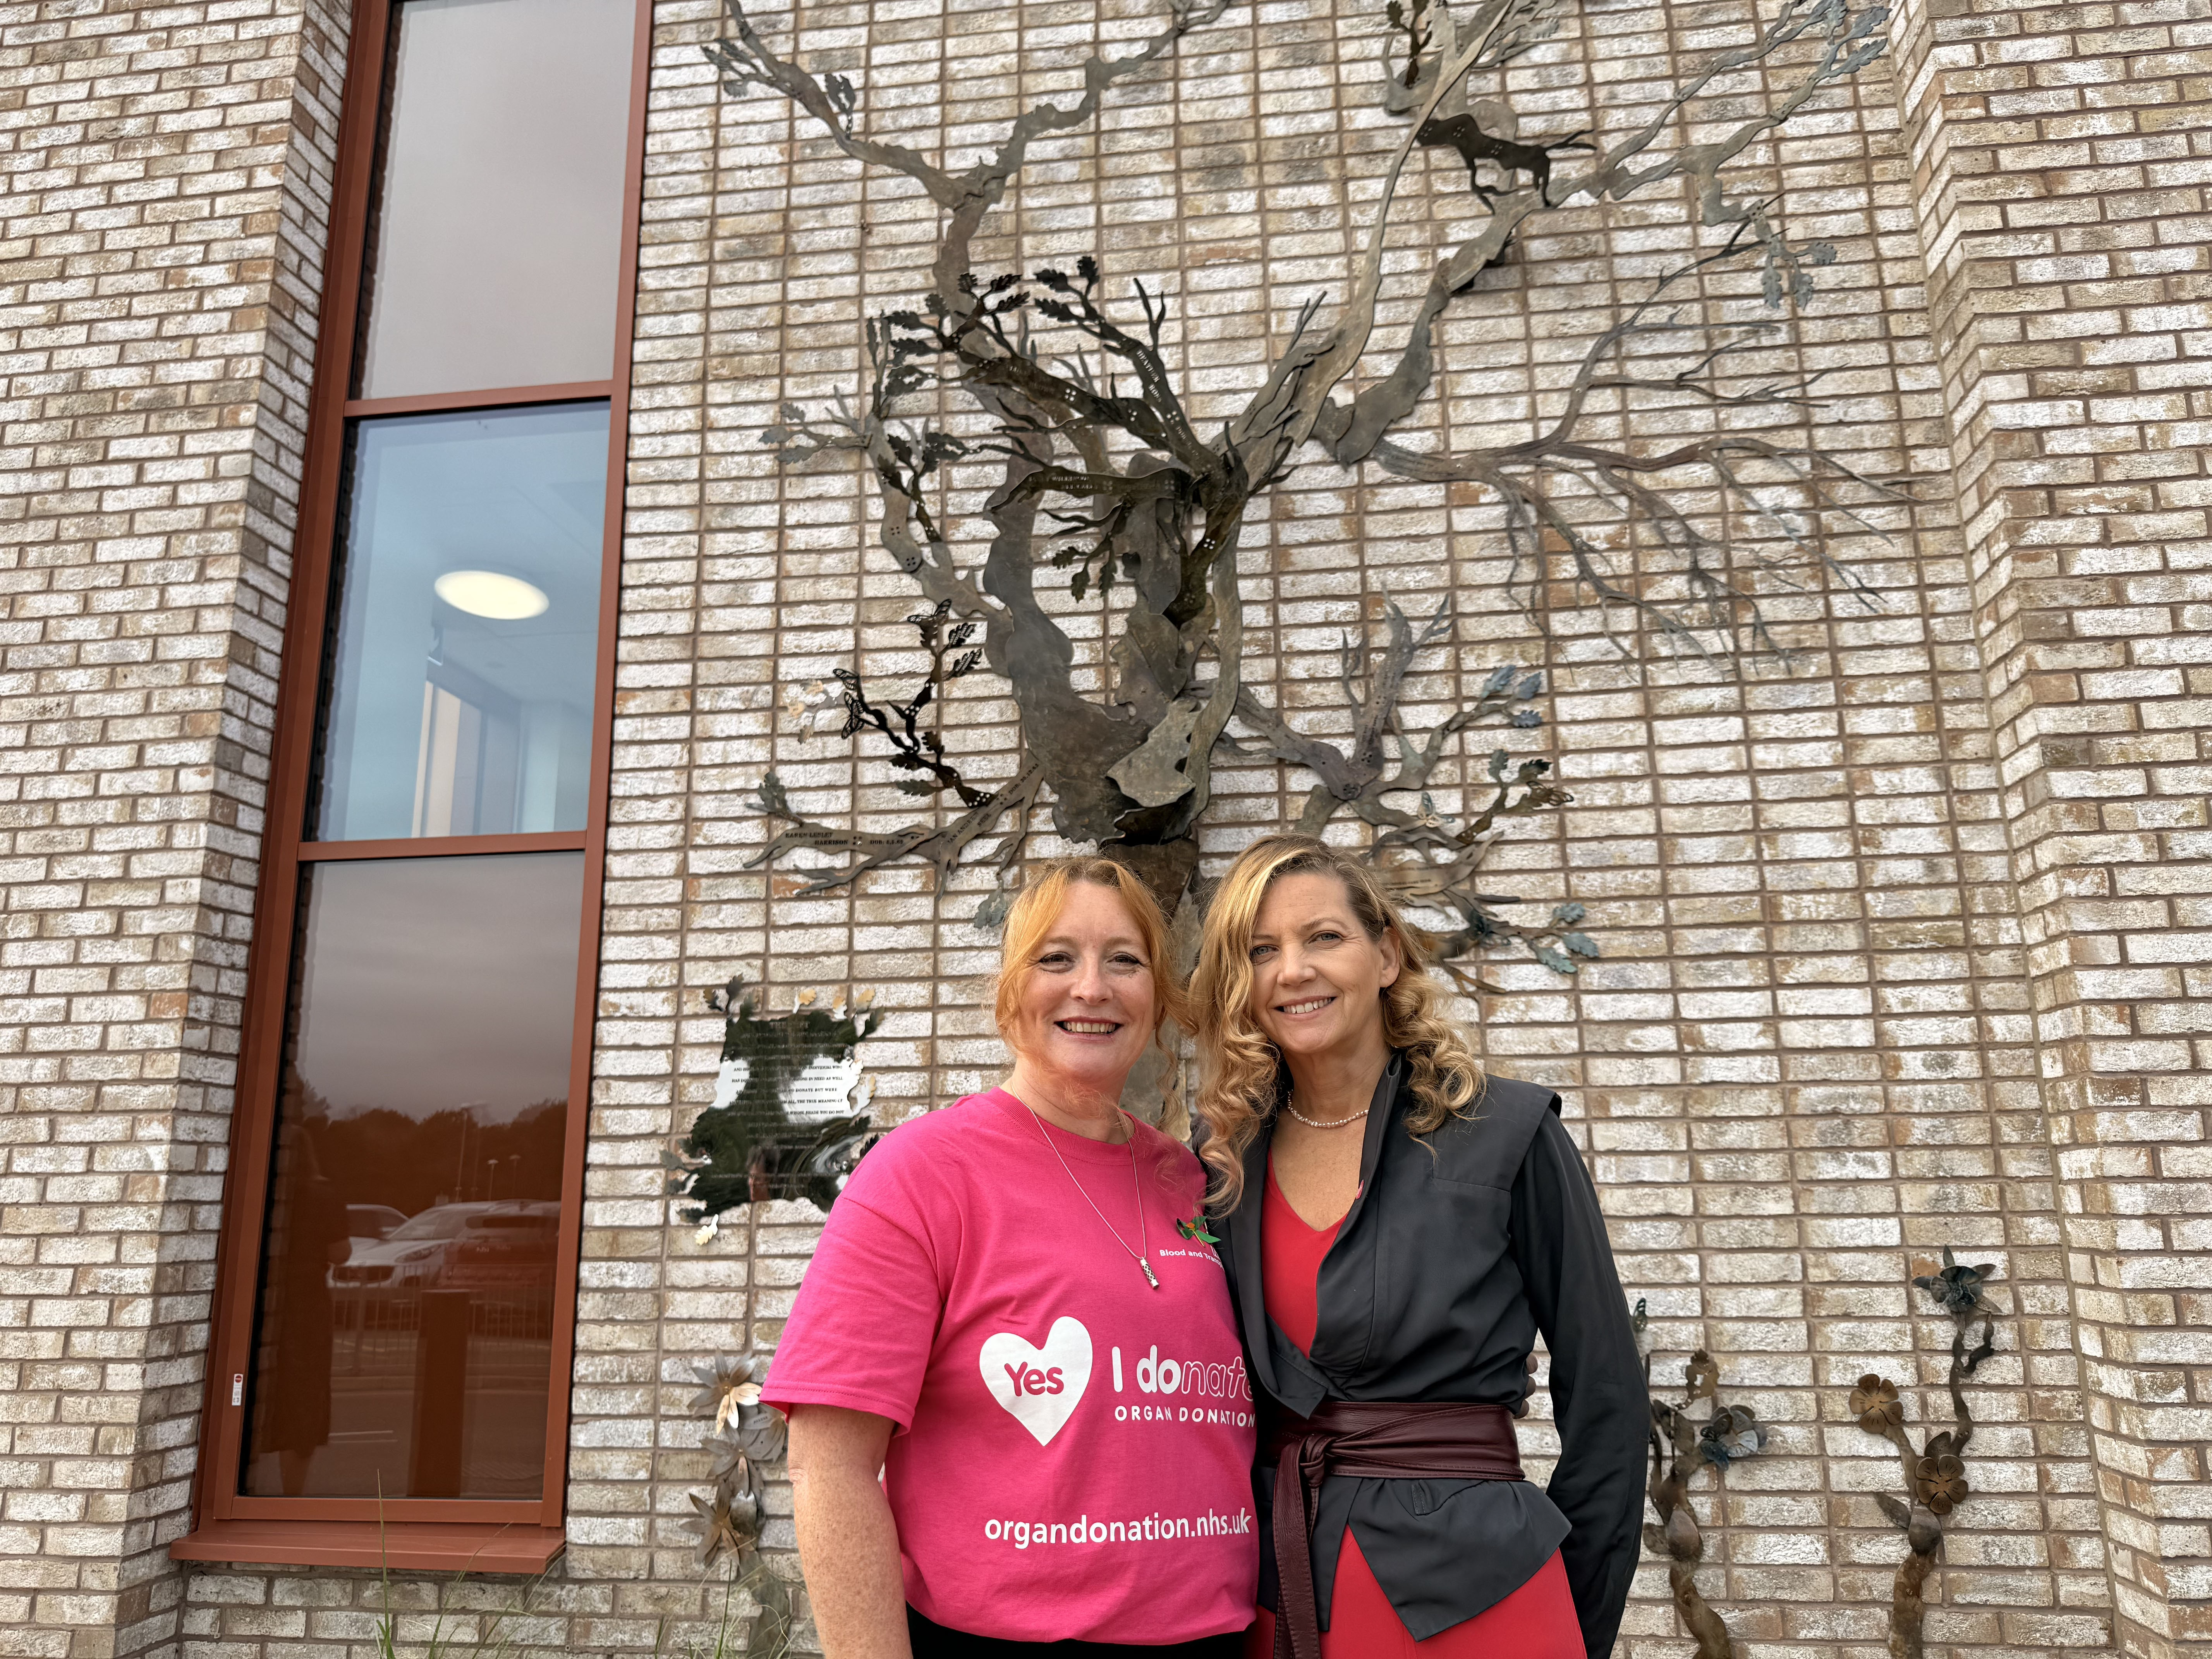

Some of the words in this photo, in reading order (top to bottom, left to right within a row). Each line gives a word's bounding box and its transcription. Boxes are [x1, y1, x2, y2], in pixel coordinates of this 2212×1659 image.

[1004, 1361, 1064, 1397] Yes
[1112, 1346, 1123, 1393] I
[1115, 1405, 1172, 1421] ORGAN
[1179, 1407, 1255, 1428] DONATION
[984, 1507, 1252, 1549] organdonation.nhs.uk
